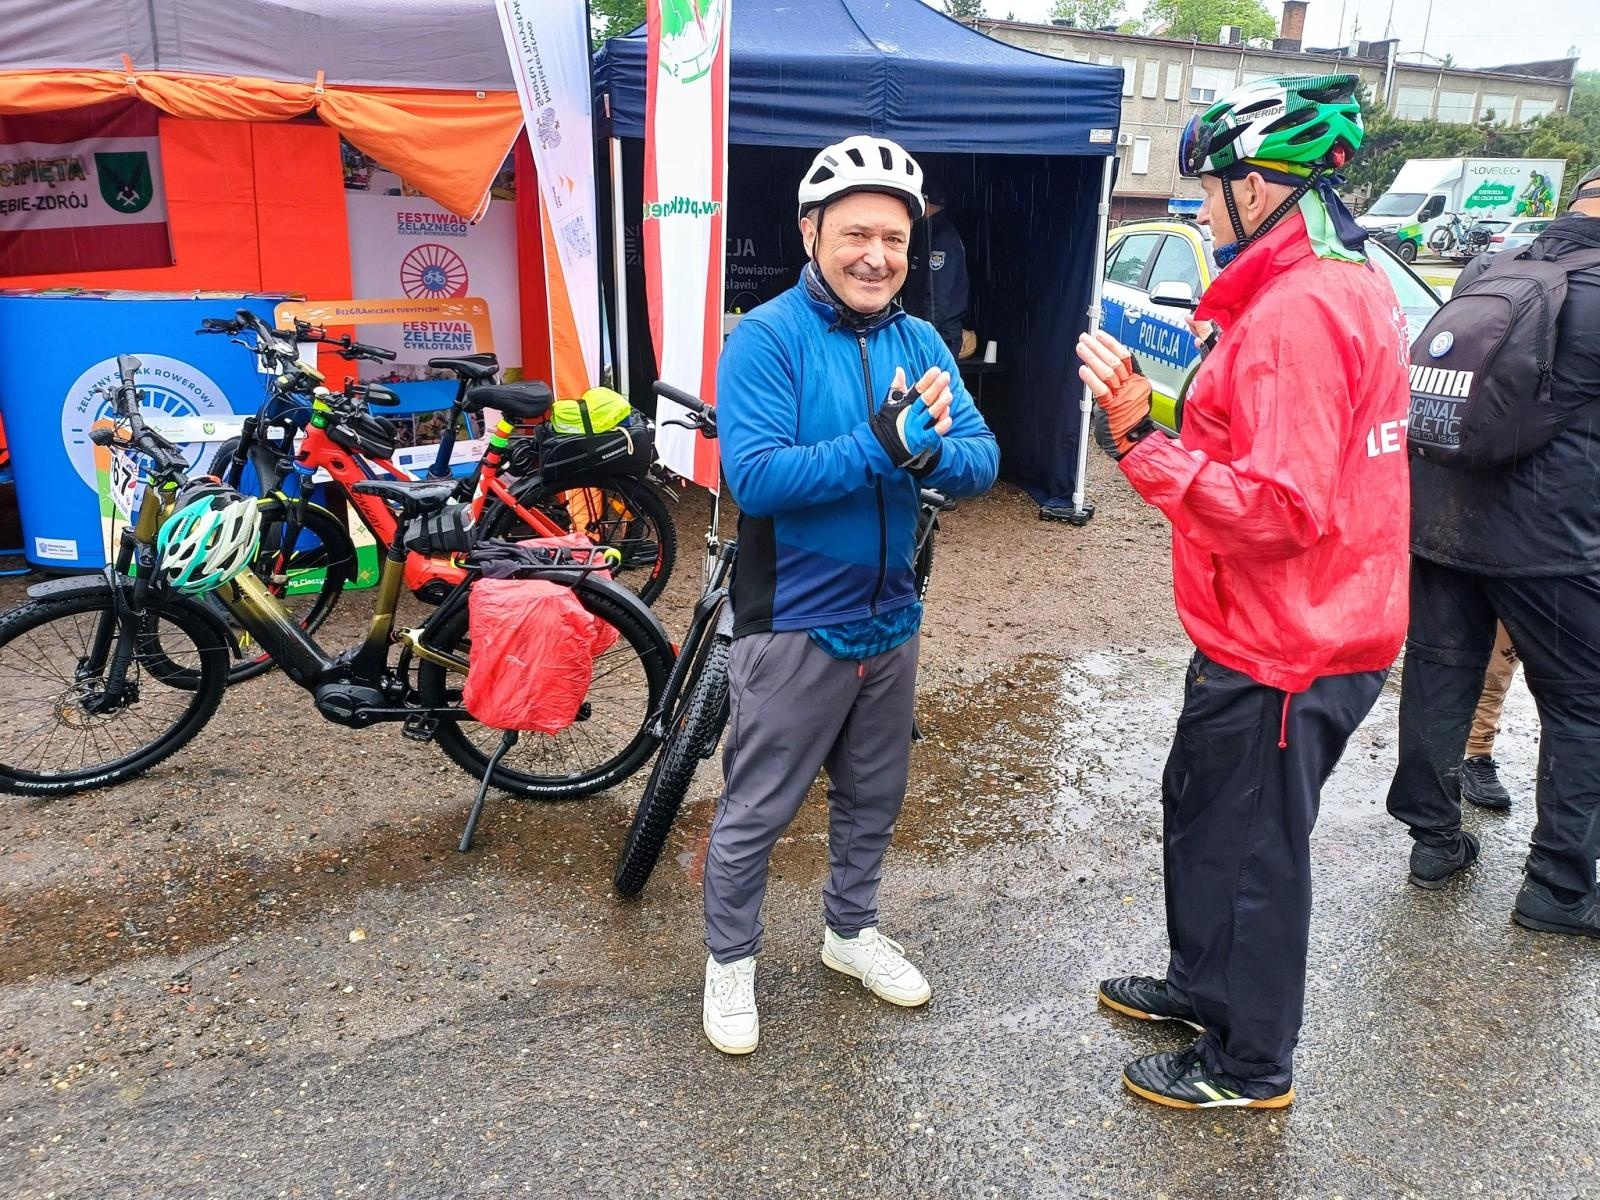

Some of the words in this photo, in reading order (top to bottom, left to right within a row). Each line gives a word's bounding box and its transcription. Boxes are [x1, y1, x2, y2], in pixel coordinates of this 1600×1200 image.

[397, 212, 467, 224] FESTIWAL
[403, 321, 471, 333] FESTIVAL
[1138, 321, 1180, 359] POLICJA
[404, 342, 472, 351] CYKLOTRASY
[114, 368, 150, 380] SAK
[155, 368, 215, 409] ROWEROWY
[1438, 434, 1460, 444] 1948
